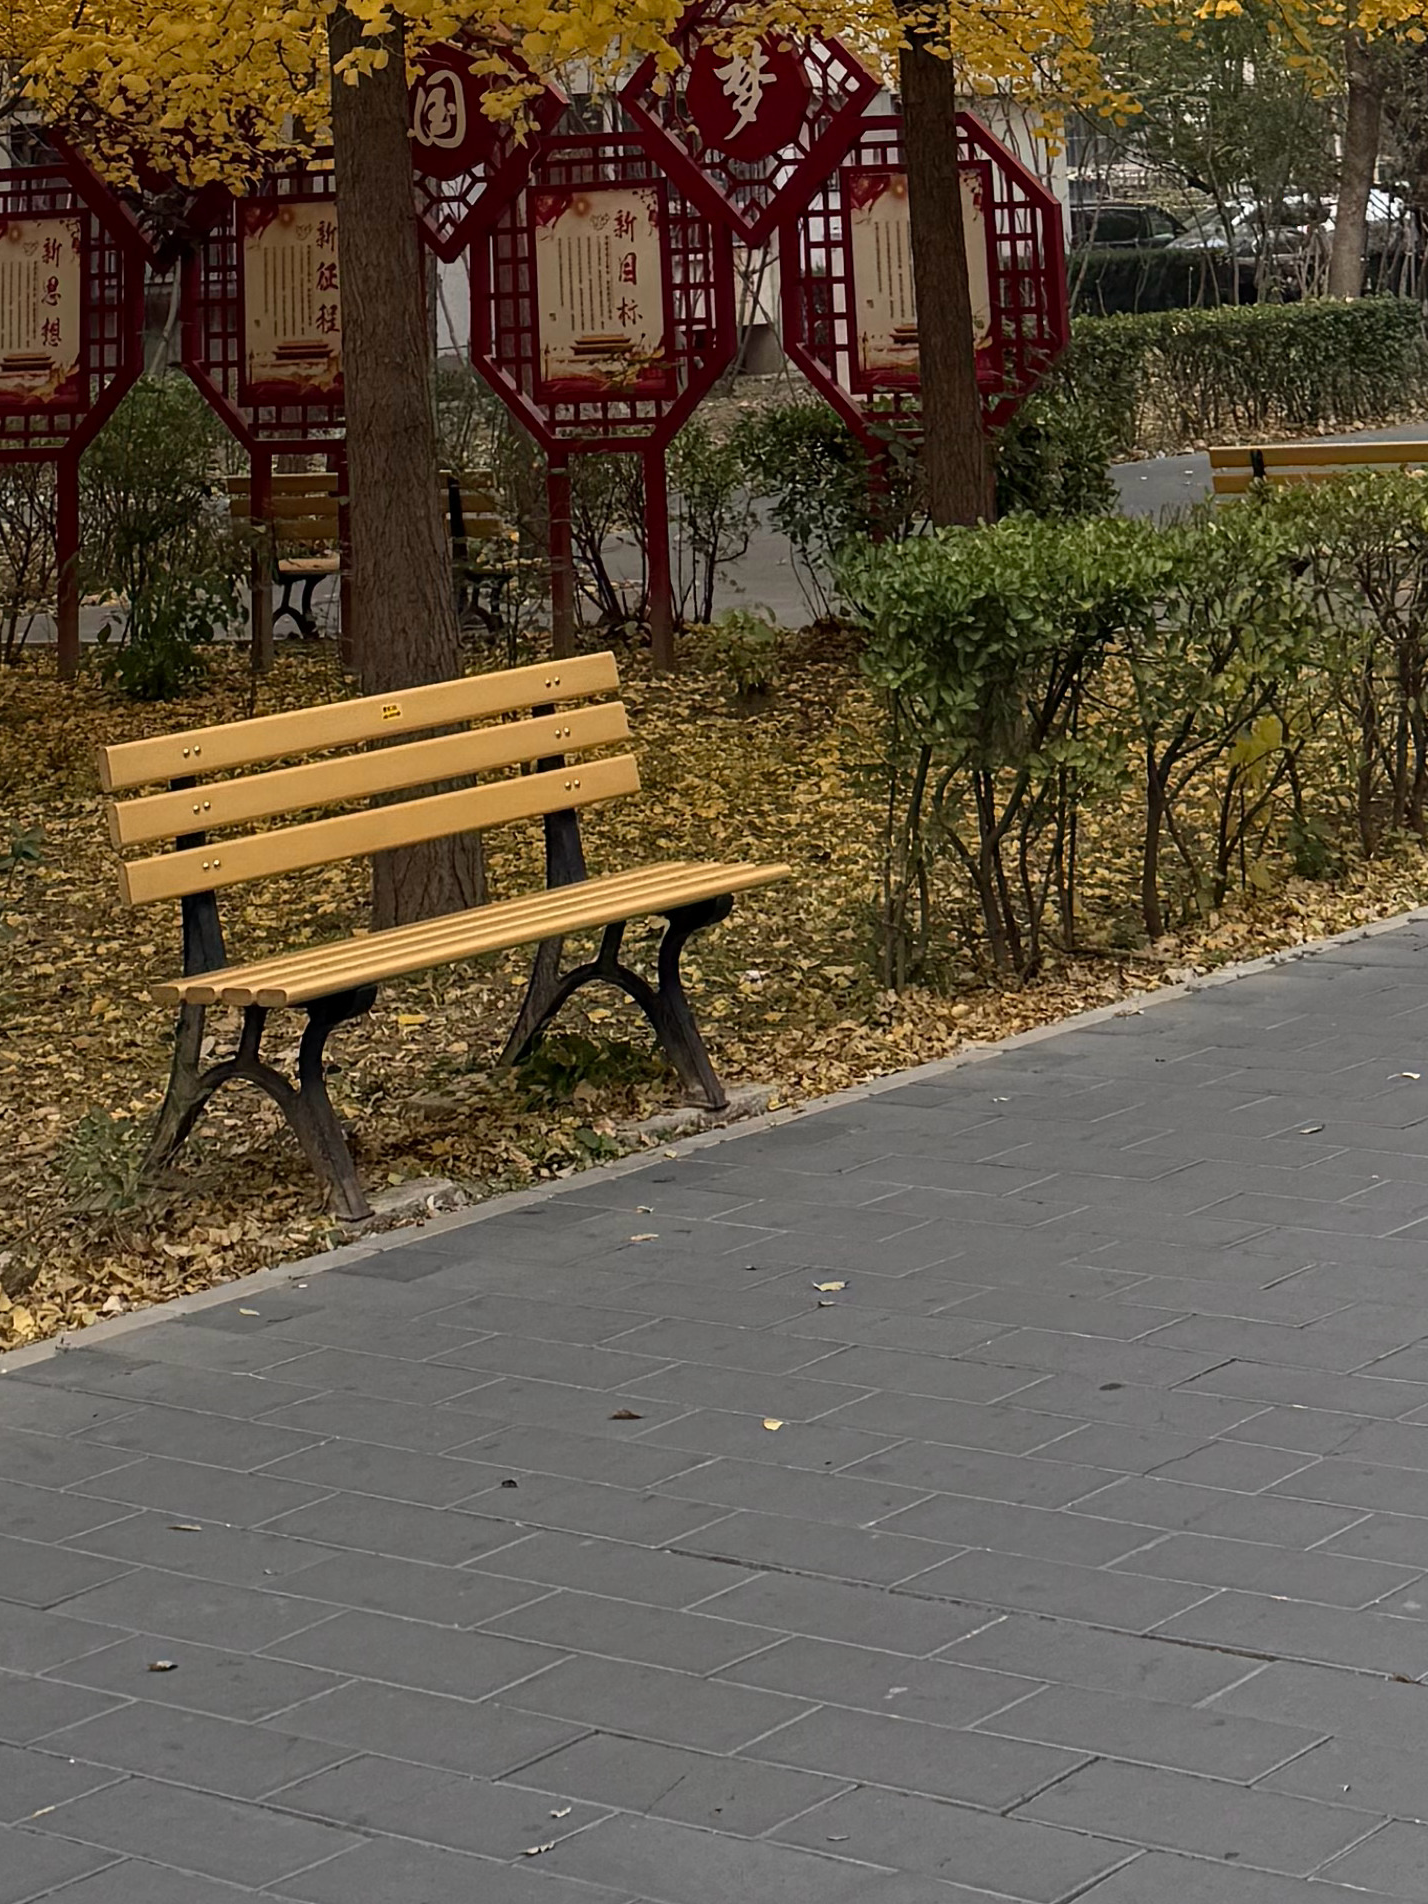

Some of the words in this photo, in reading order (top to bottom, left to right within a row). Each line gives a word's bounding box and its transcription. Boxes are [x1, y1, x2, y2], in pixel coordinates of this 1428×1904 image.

[713, 39, 778, 141] 梦
[41, 236, 63, 348] 新思想
[315, 220, 340, 334] 新征程
[613, 209, 643, 328] 新目标
